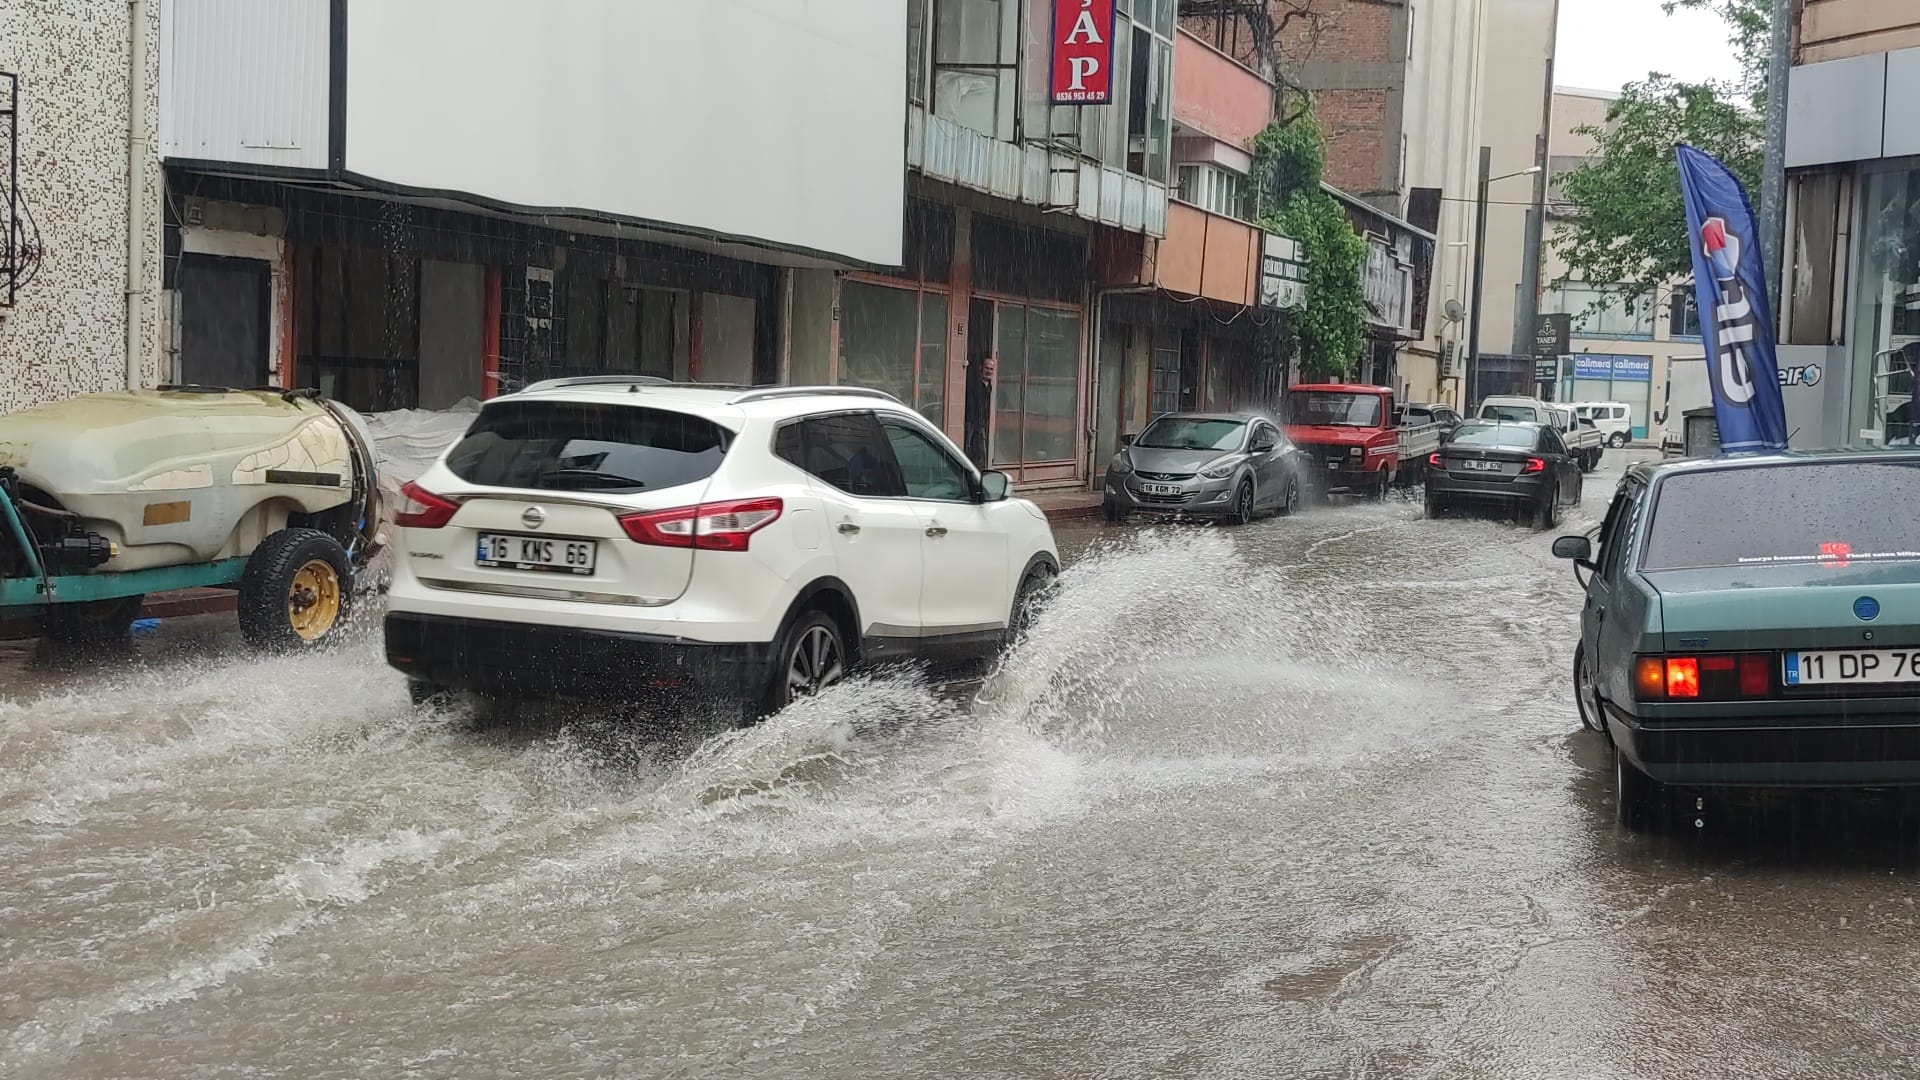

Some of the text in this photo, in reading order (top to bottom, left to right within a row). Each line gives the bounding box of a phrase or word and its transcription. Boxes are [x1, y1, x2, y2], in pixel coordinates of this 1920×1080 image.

[1056, 90, 1105, 101] 0536 953 45 29
[1576, 357, 1611, 369] calimera
[1614, 358, 1649, 370] calimera
[1778, 367, 1804, 385] elf
[1145, 484, 1153, 492] 16
[1171, 486, 1181, 494] 72
[491, 537, 588, 564] 16 KNS 66
[1802, 652, 1920, 680] 11 DP 76
[1786, 670, 1798, 678] TR
